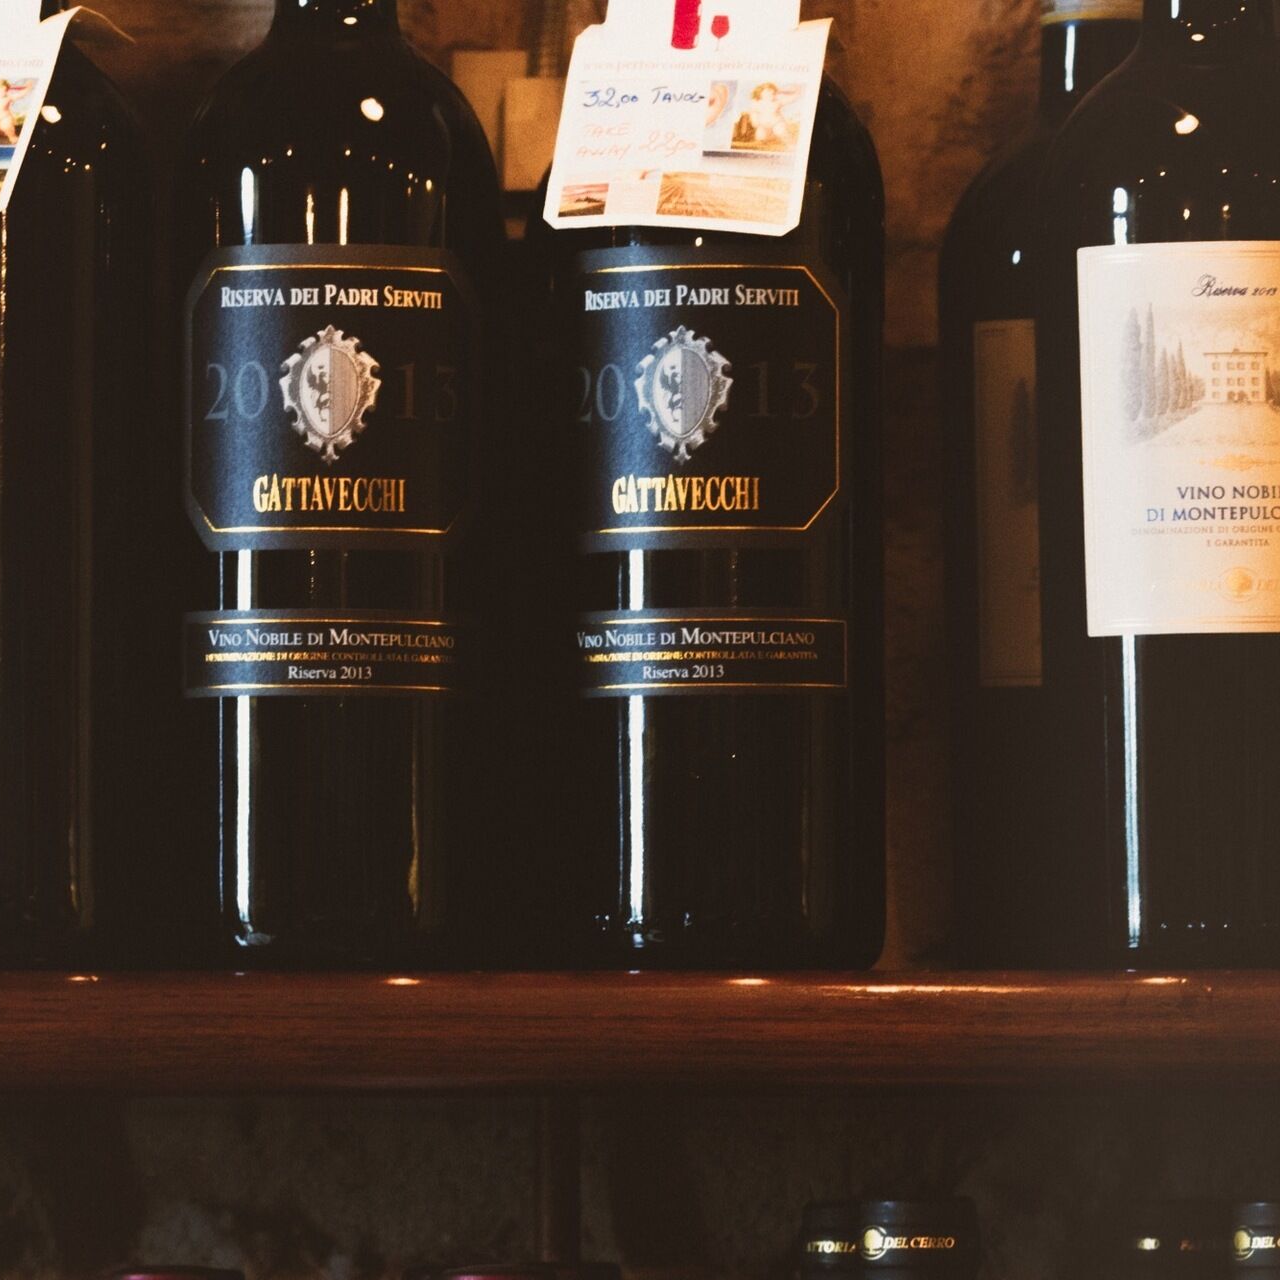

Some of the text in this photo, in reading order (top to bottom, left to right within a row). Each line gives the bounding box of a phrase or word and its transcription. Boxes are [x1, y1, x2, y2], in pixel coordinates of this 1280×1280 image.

[221, 284, 443, 309] RISERVA DEI PADRI SERVITI
[584, 284, 800, 311] RISERVA DEI PADRI SERVITI
[252, 473, 407, 513] GATTAVECCHI
[611, 473, 761, 514] GATTAVECCHI
[1176, 485, 1226, 501] VINO
[1145, 507, 1165, 523] DI
[208, 628, 455, 648] VINO NOBILE DI MONTEPULCIANO
[604, 627, 815, 648] NOBILE DI MONTEPULCIANO
[287, 665, 372, 680] Riserva 2013
[642, 664, 724, 680] Riserva 2013
[910, 1235, 956, 1249] CERRO
